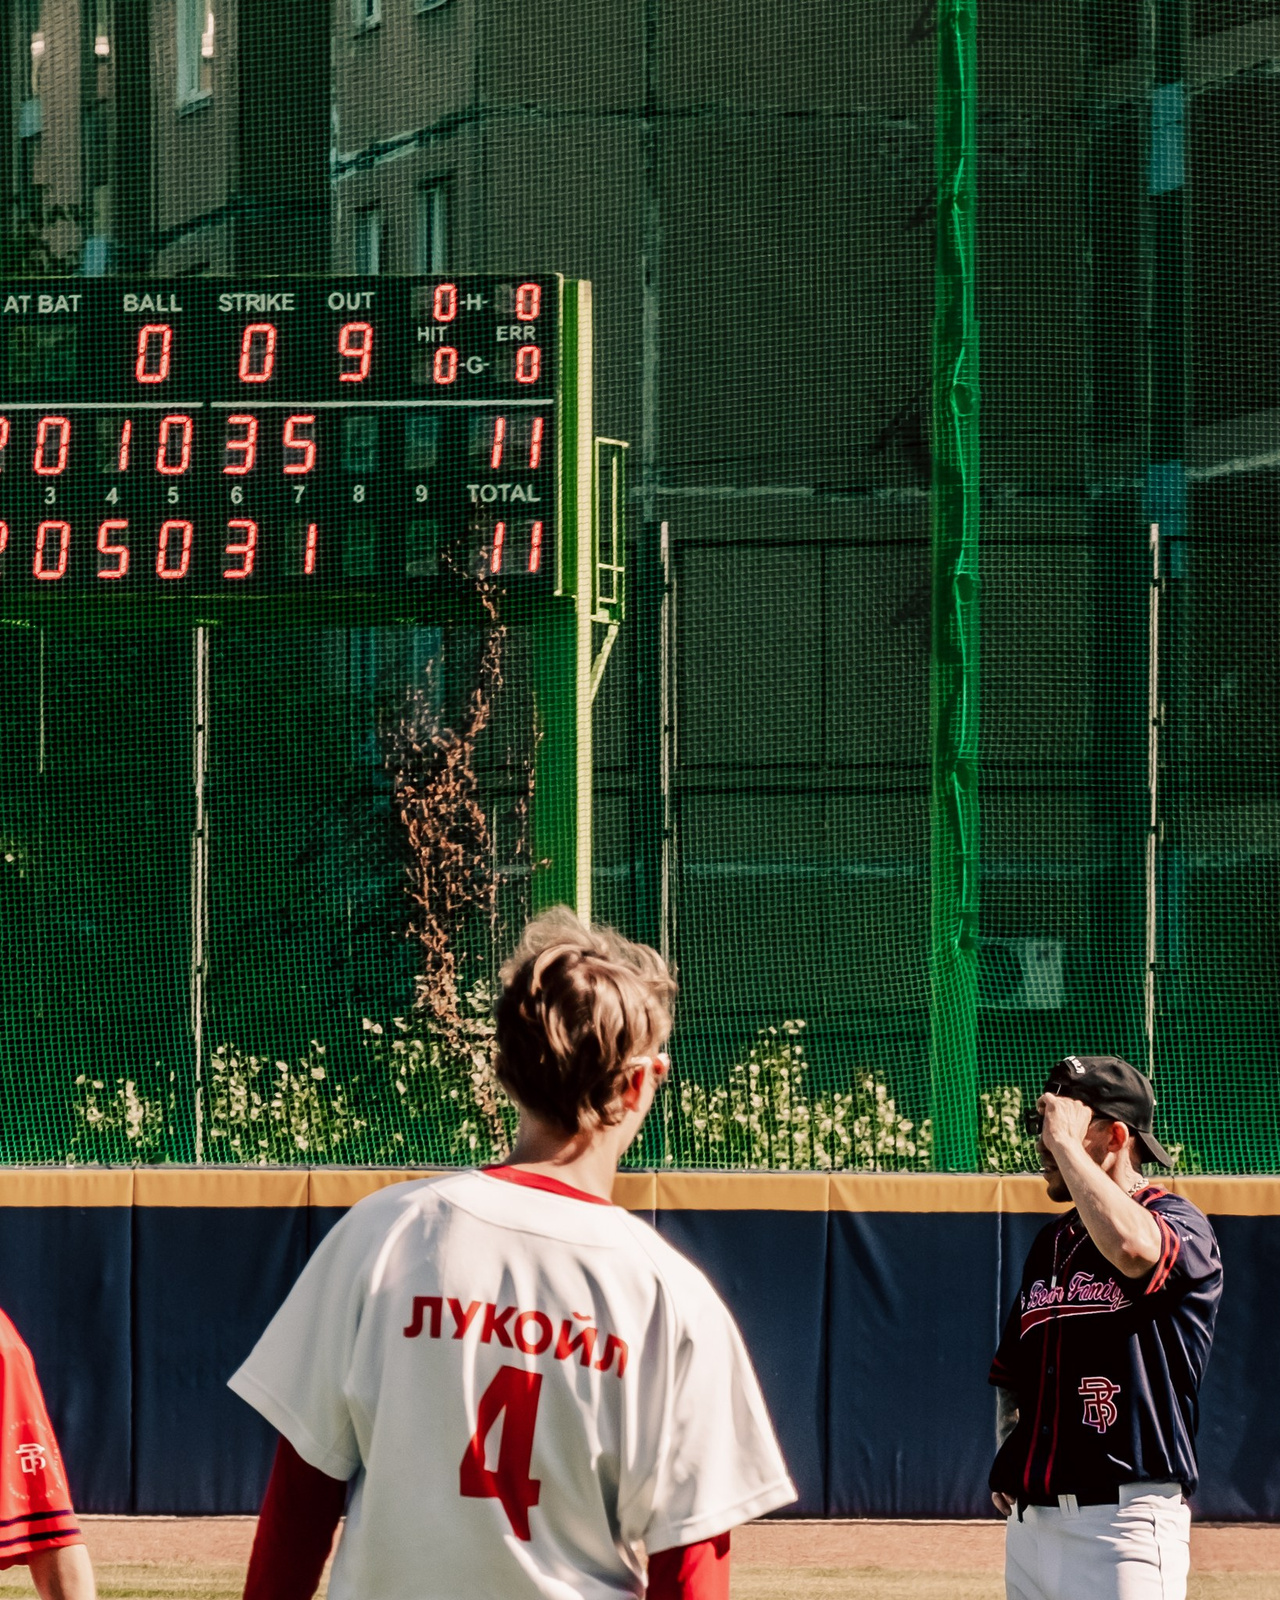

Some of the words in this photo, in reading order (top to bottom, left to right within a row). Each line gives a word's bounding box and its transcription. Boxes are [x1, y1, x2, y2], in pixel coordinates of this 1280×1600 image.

[4, 295, 31, 313] AT
[38, 294, 82, 313] BAT
[123, 294, 183, 312] BALL
[218, 293, 295, 312] STRIKE
[328, 292, 375, 310] OUT
[433, 283, 457, 322] 0
[516, 283, 541, 321] 0
[338, 322, 373, 382] 9
[417, 326, 448, 342] HIT
[496, 325, 536, 341] ERR
[136, 323, 173, 383] 0
[239, 323, 277, 383] 0
[433, 346, 457, 384] 0
[515, 345, 541, 384] 0
[490, 417, 544, 469] 11
[44, 486, 56, 504] 3
[105, 487, 118, 505] 4
[167, 486, 179, 504] 5
[230, 486, 243, 504] 6
[293, 485, 305, 503] 7
[353, 485, 365, 503] 8
[415, 484, 428, 502] 9
[466, 484, 541, 502] TOTAL
[490, 521, 543, 574] 11
[403, 1296, 629, 1379] ЛУКОЙЛ
[460, 1365, 543, 1541] 4
